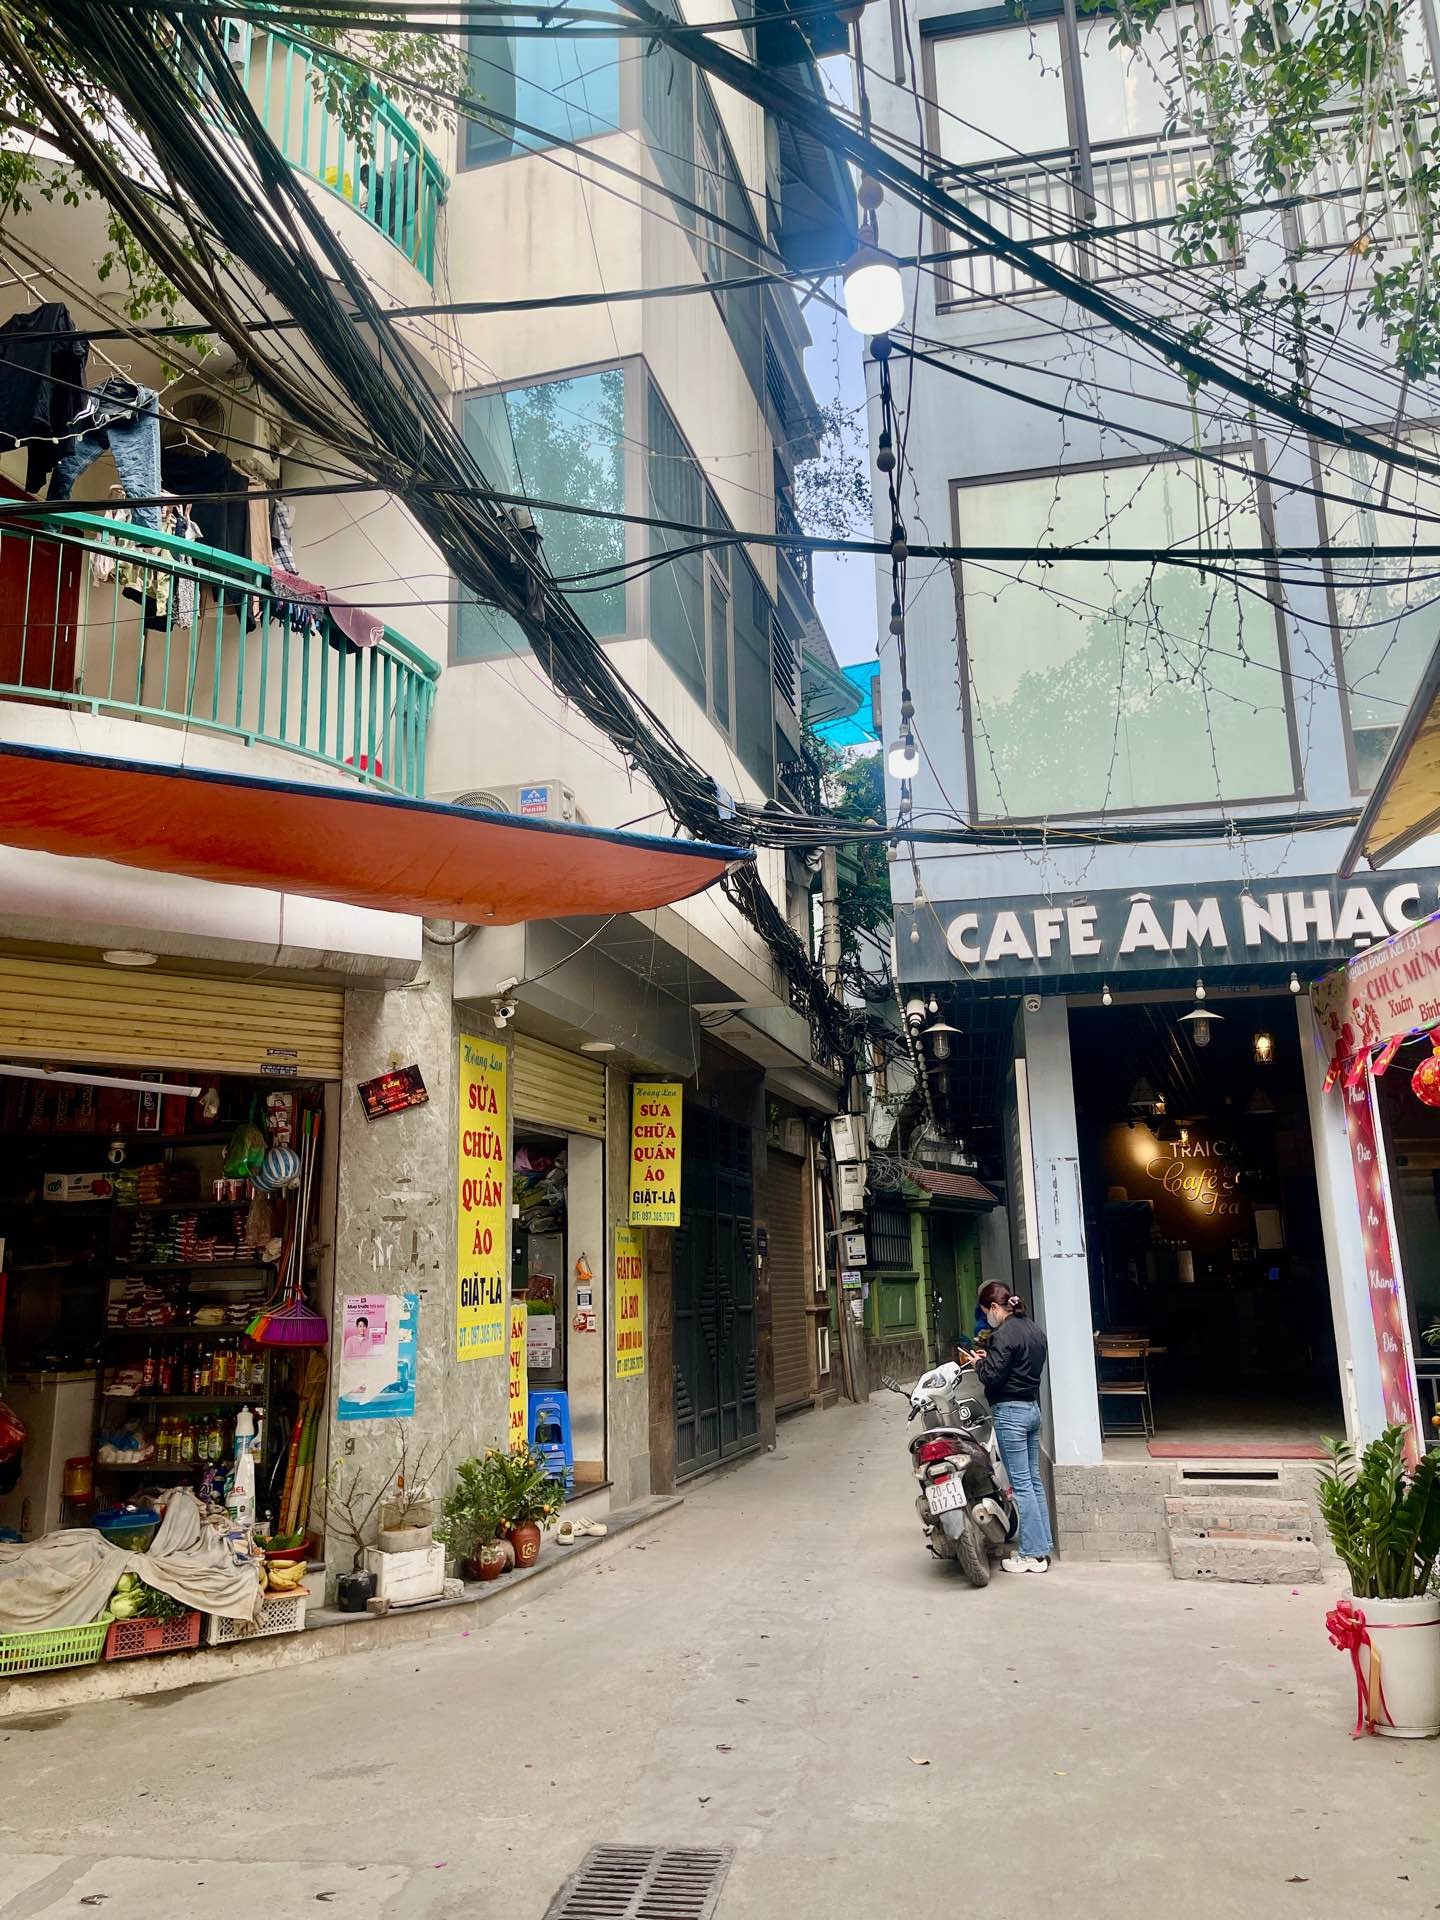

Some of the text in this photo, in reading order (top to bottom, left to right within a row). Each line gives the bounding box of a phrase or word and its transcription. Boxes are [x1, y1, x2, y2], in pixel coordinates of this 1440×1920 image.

[1119, 892, 1228, 953] ÂM
[1241, 883, 1420, 948] NHẠC
[1366, 967, 1403, 1000] CHÚC
[489, 1053, 503, 1073] Lan
[468, 1075, 498, 1114] SỬA
[640, 1100, 671, 1117] SỬA
[634, 1122, 676, 1138] CHỮA
[462, 1126, 503, 1161] CHỮA
[633, 1141, 676, 1162] QUẦN
[644, 1165, 665, 1181] ÁO
[1146, 1157, 1218, 1200] Café
[462, 1167, 502, 1212] QUẦN
[632, 1187, 676, 1207] GIẶT-LÀ
[1200, 1191, 1240, 1216] Tea
[472, 1220, 493, 1255] ÁO
[461, 1271, 502, 1312] GIẶT-LÀ
[511, 1317, 523, 1339] ÁN
[510, 1410, 524, 1429] AM
